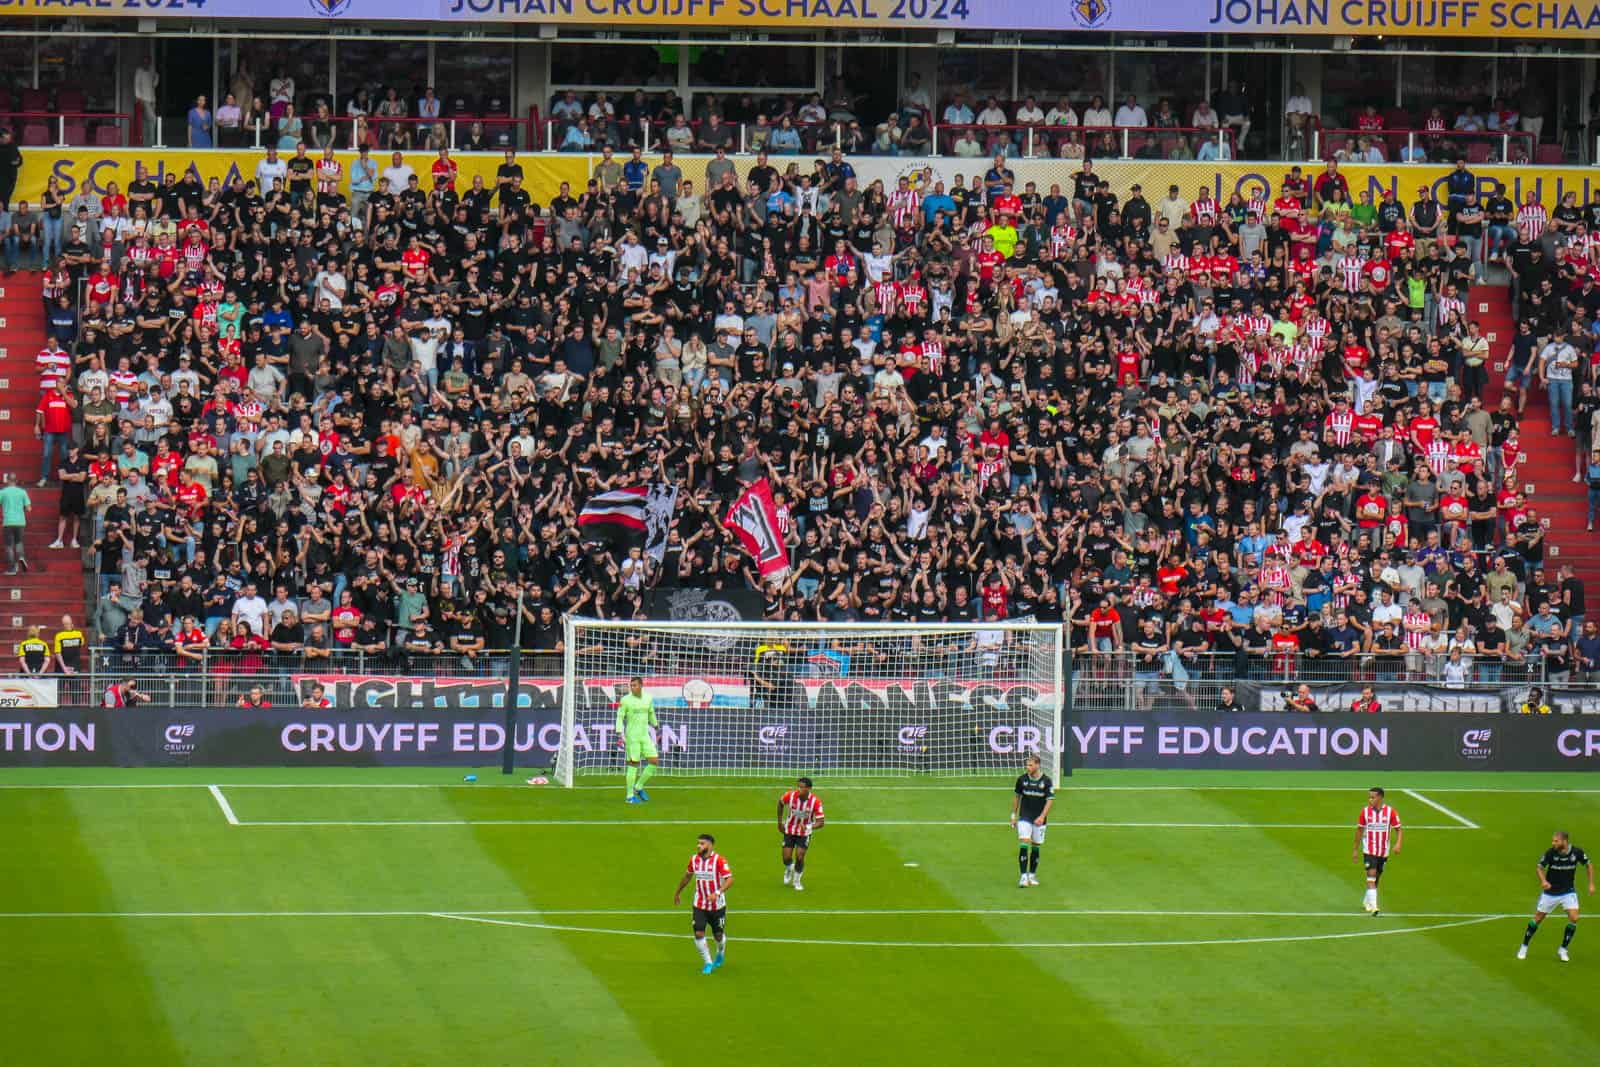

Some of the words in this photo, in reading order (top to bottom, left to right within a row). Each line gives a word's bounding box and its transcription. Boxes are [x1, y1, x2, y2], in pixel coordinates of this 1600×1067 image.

[584, 0, 724, 17] CRUIJFF
[738, 0, 878, 19] SCHAAL
[888, 0, 969, 20] 2024
[1209, 0, 1328, 25] JOHAN
[1341, 1, 1479, 28] CRUIJFF
[0, 723, 96, 752] TION
[281, 723, 438, 752] CRUYFF
[453, 724, 687, 752] EDUCATN
[988, 725, 1145, 754] CRUYFF
[1157, 727, 1389, 756] EDUCATION
